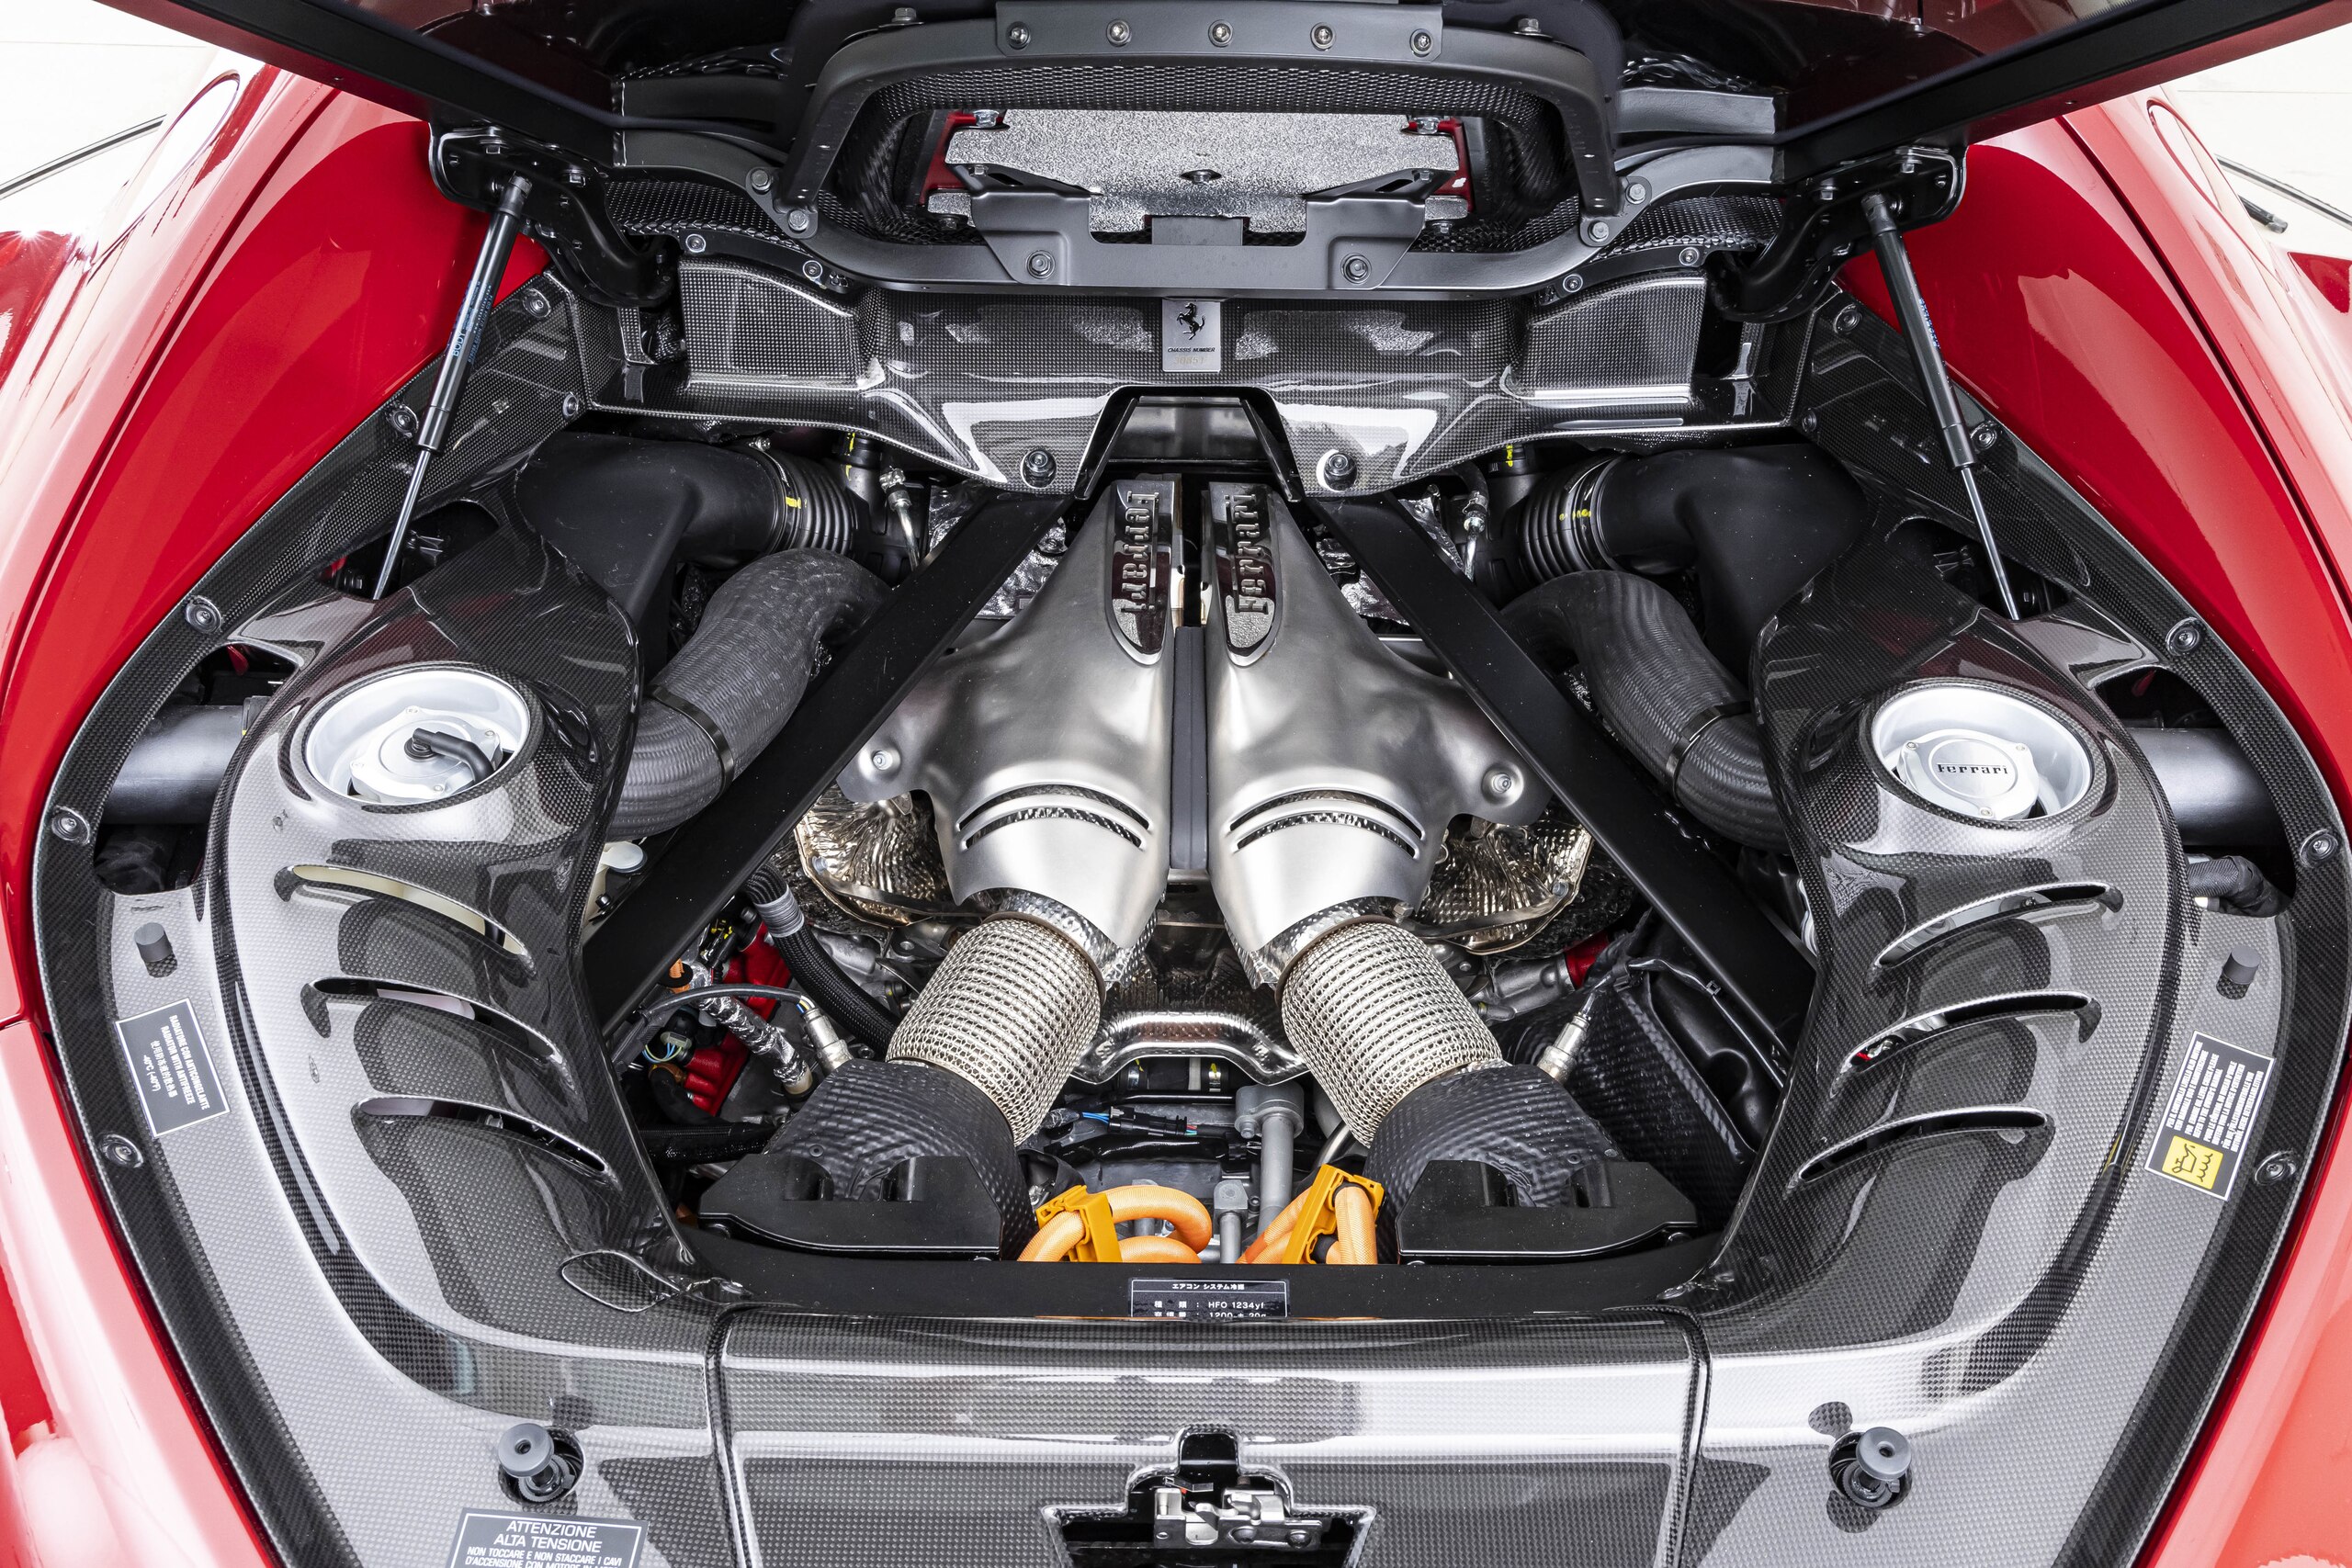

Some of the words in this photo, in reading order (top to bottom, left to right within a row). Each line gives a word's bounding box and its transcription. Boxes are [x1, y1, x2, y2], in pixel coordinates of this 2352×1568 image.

[452, 333, 465, 356] BODY
[1120, 491, 1159, 613] Ferrari
[1224, 493, 1268, 615] Ferrari
[1936, 763, 2007, 773] Ferrari
[161, 1026, 177, 1055] RADIATOR
[169, 1015, 187, 1047] RADIATORE
[171, 1054, 183, 1070] WITH
[181, 1046, 191, 1059] CON
[176, 1070, 196, 1104] ANTIFREEZE
[185, 1059, 209, 1110] ANTICONGELANTE
[1232, 1302, 1265, 1310] 1234yf
[506, 1520, 597, 1539] ATTENZIONE
[493, 1533, 526, 1547] ALTA
[531, 1536, 603, 1553] TENSIONE
[465, 1556, 523, 1568] D'ACCENSIONE
[467, 1547, 486, 1556] NON
[489, 1549, 526, 1560] TOCCARE
[526, 1551, 533, 1560] E
[534, 1551, 553, 1562] NON
[554, 1553, 596, 1564] STACCARE
[603, 1557, 622, 1566] CAVI
